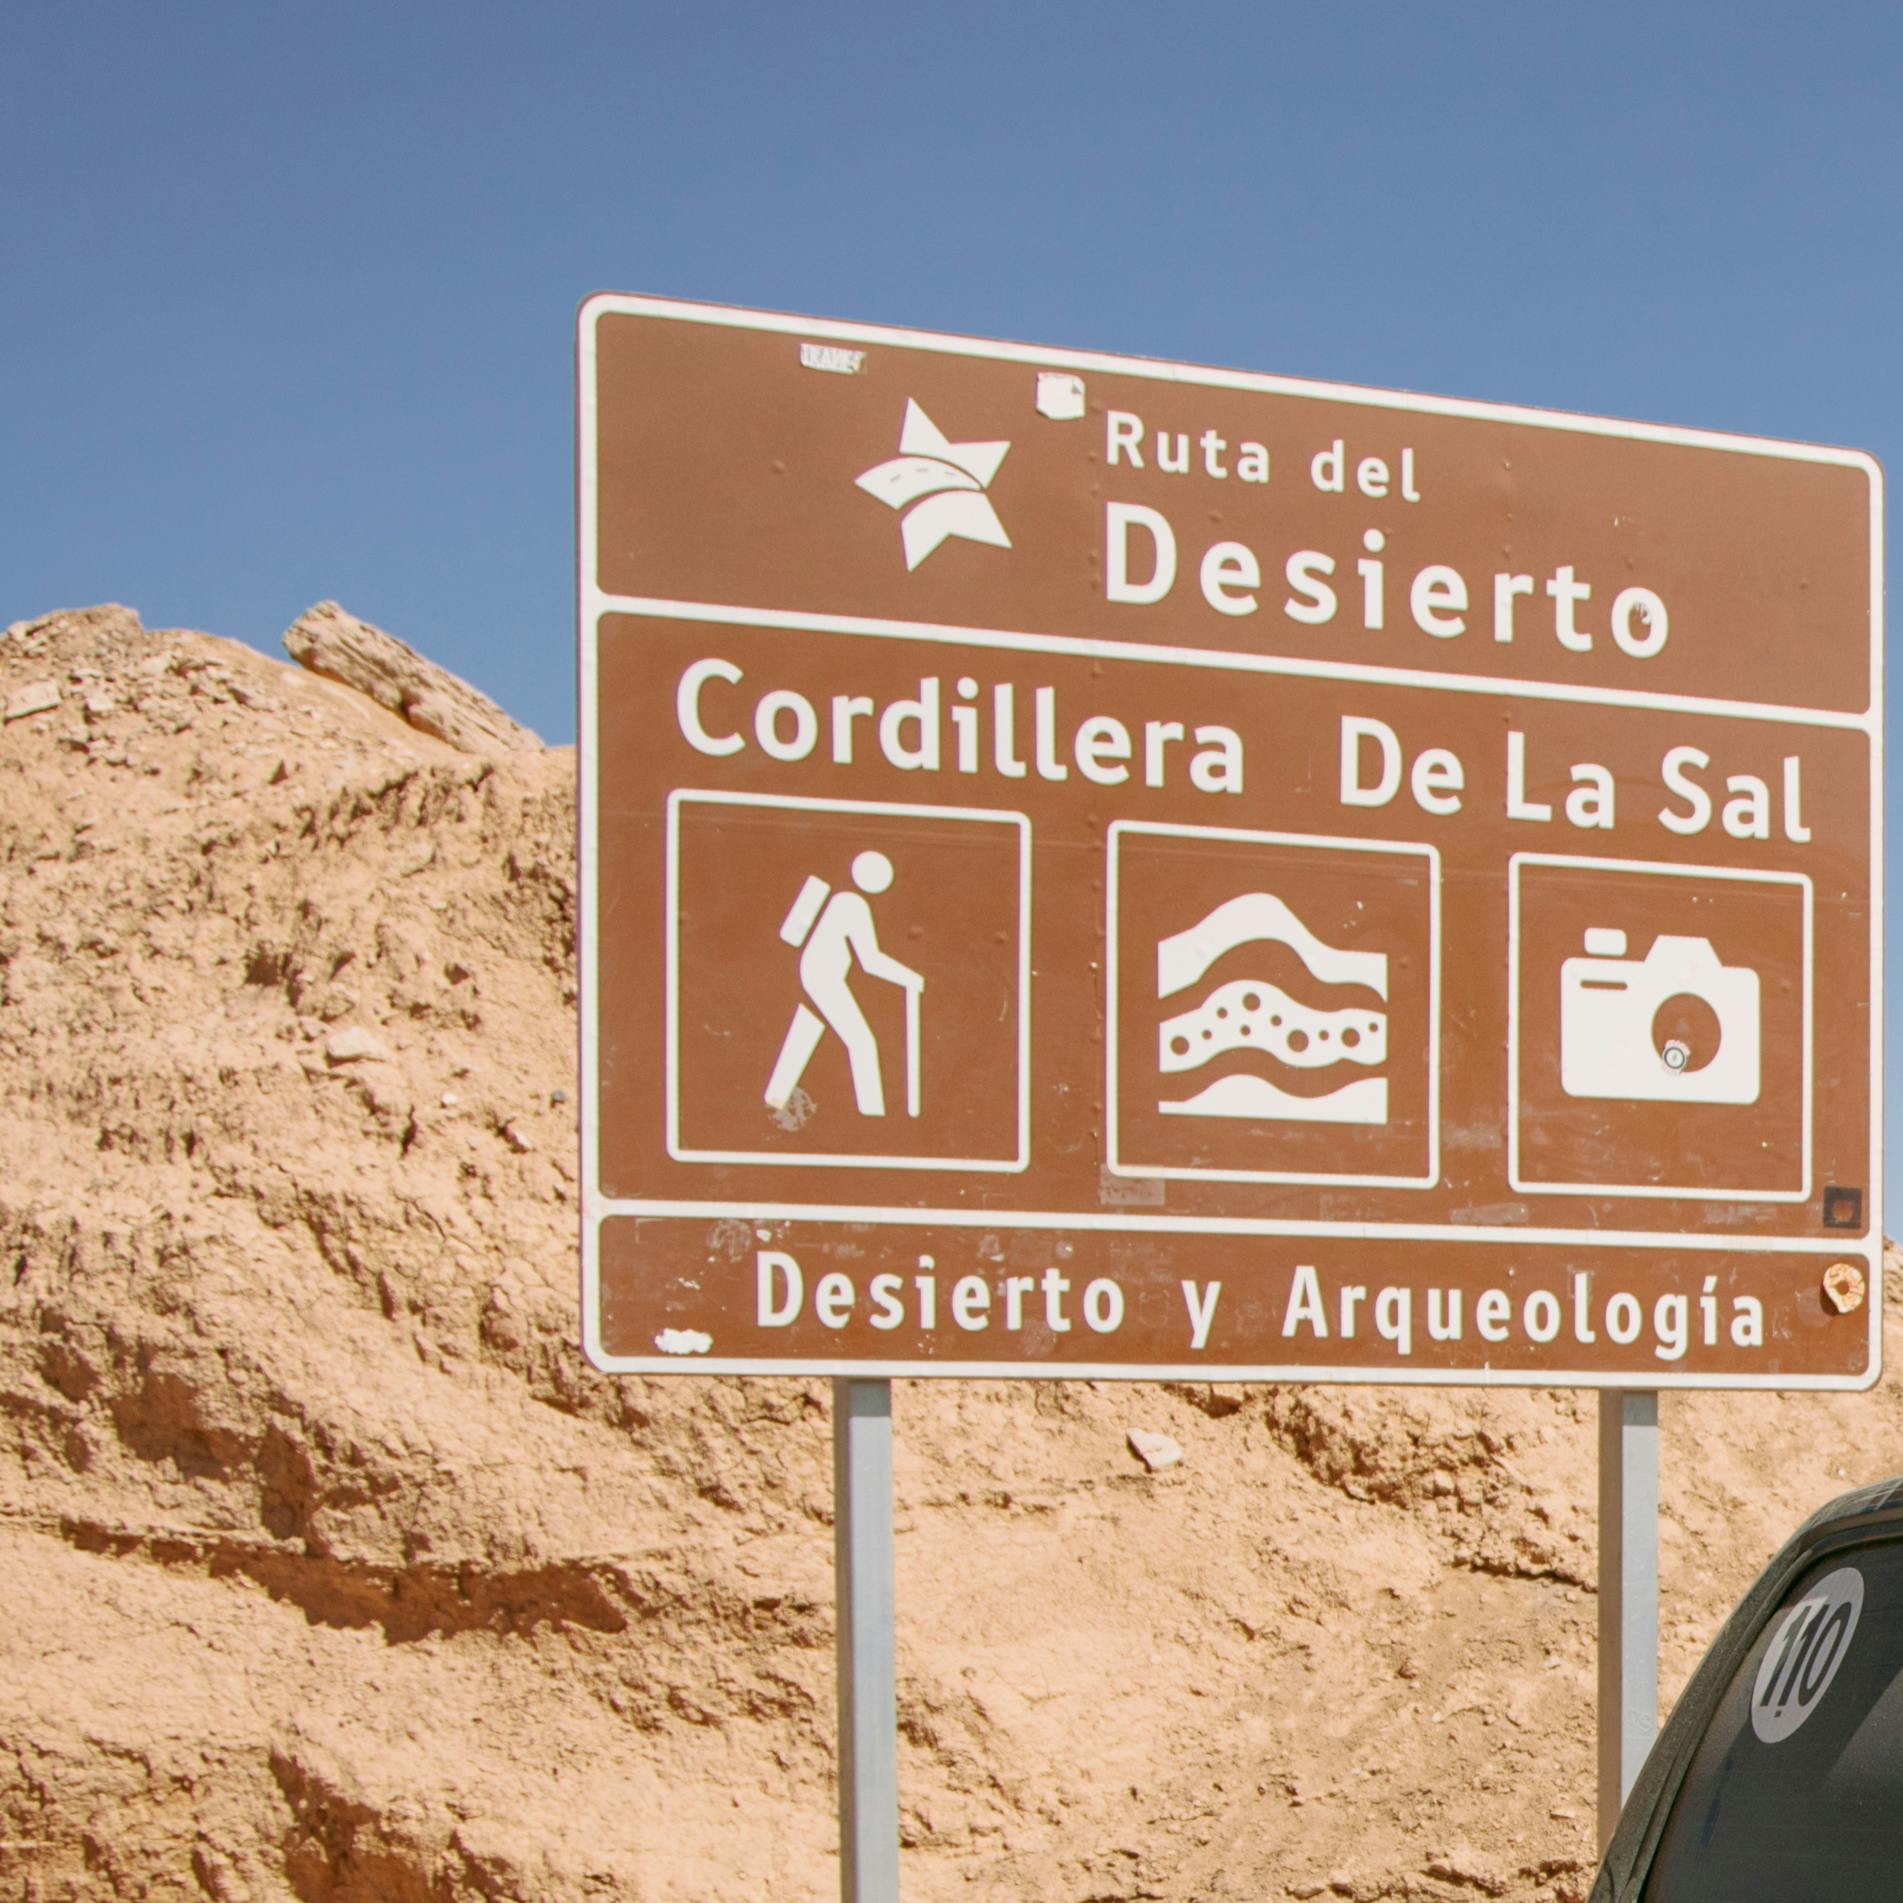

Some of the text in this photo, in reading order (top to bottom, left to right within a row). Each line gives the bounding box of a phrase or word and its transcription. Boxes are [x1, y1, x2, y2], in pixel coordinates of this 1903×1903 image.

[1106, 410, 1420, 502] Ruta del
[1106, 501, 1668, 657] Desierto
[676, 658, 1811, 842] Cordillera De La Sal
[757, 1251, 1762, 1361] Desierto y Arqueología
